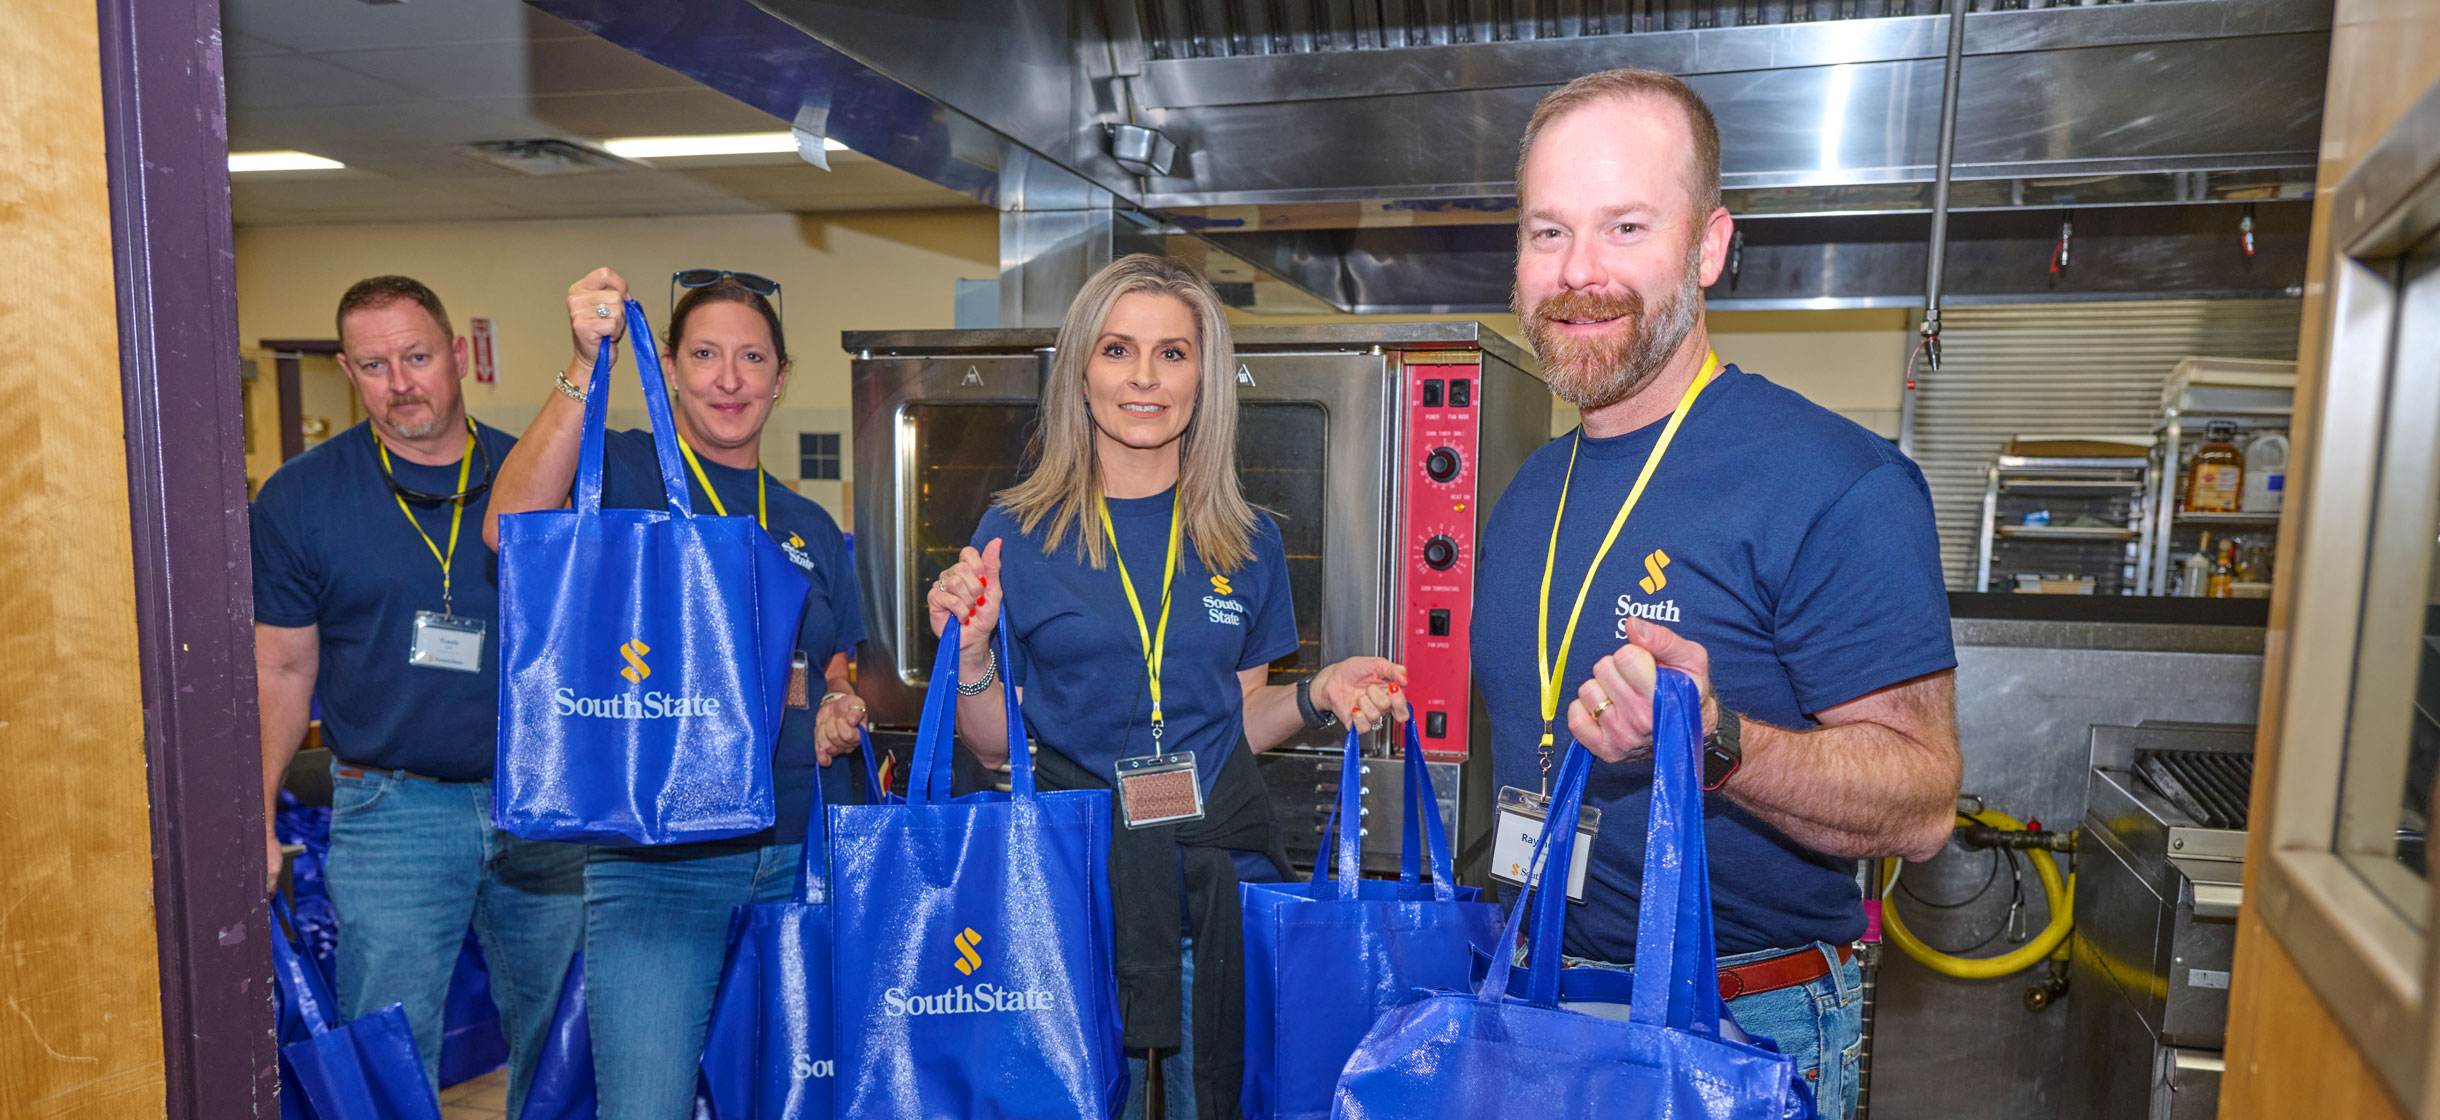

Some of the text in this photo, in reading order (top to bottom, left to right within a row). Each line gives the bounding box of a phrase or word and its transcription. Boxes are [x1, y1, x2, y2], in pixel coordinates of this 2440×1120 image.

[1202, 595, 1243, 613] South
[1208, 608, 1240, 626] State
[1615, 594, 1680, 622] South
[555, 687, 720, 719] SouthState
[884, 983, 1055, 1017] SouthState
